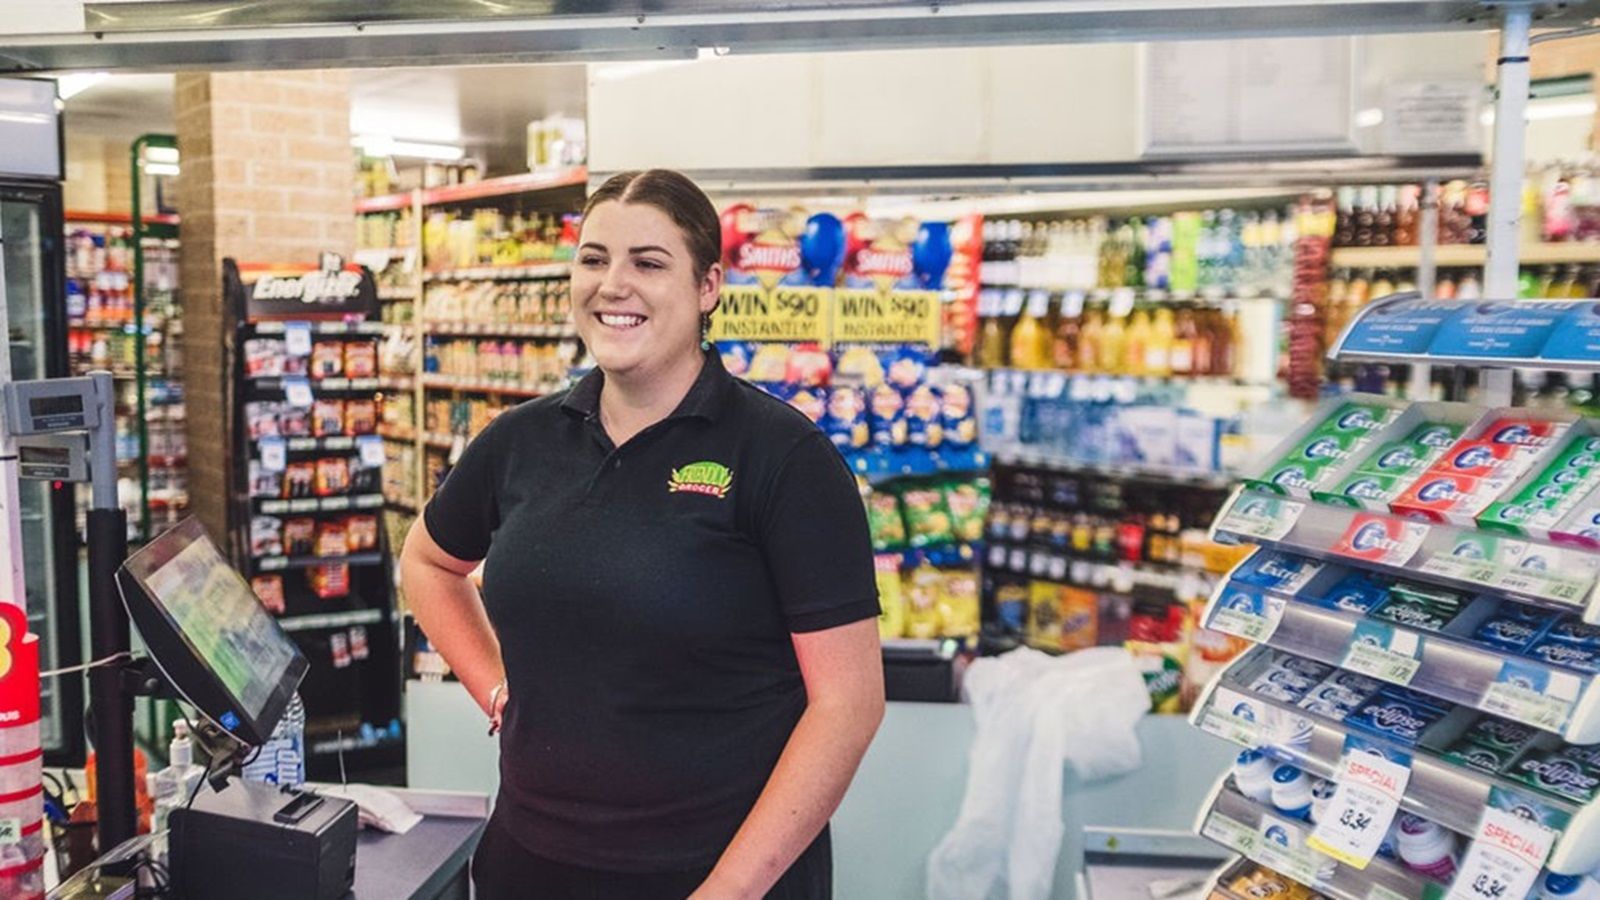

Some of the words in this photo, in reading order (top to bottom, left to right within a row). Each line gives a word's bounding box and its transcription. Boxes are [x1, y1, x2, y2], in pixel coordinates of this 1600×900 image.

[721, 293, 768, 316] WIN
[776, 293, 819, 318] $90
[842, 296, 883, 318] WIN
[1362, 704, 1426, 729] eclipse
[1520, 759, 1600, 789] eclipse
[1483, 822, 1542, 860] SPECIAL
